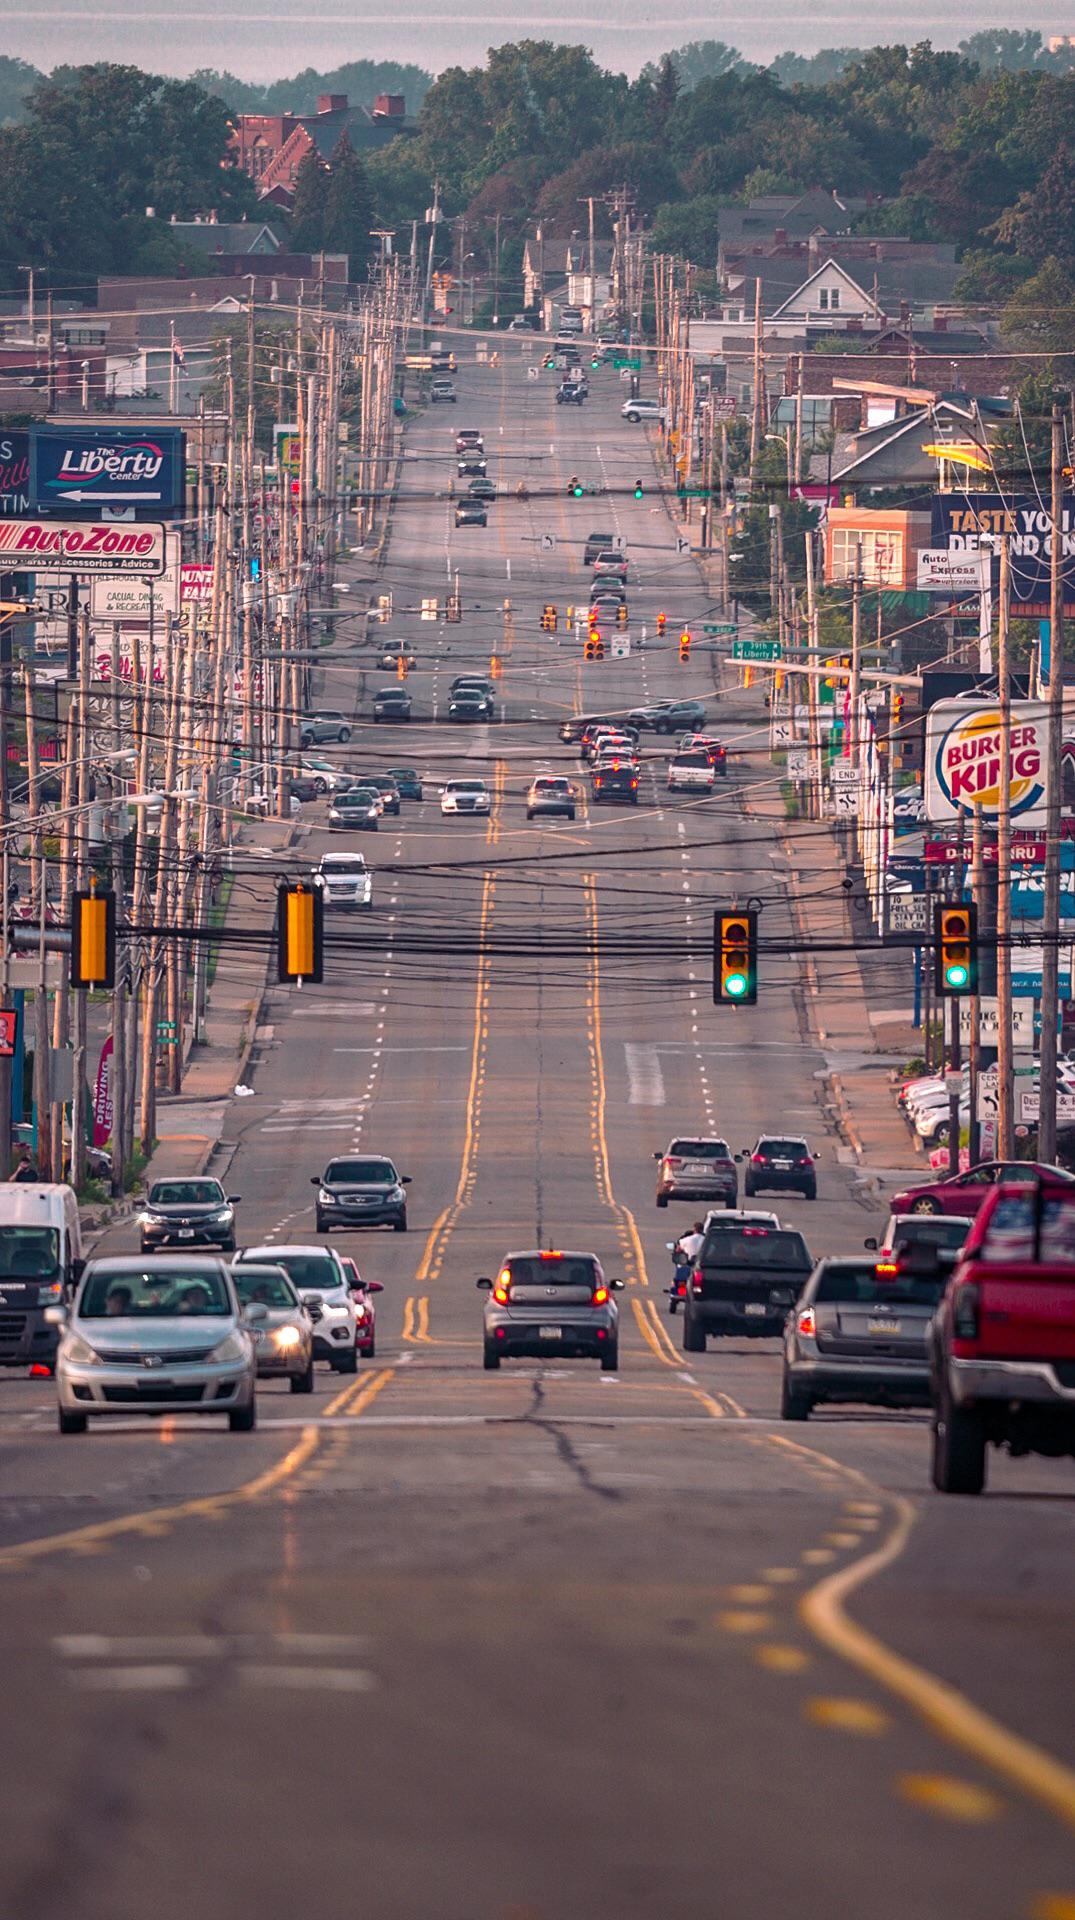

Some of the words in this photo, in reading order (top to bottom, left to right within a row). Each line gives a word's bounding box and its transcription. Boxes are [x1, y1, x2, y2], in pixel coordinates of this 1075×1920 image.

[97, 447, 115, 456] The
[60, 448, 163, 479] Liberty
[109, 472, 142, 481] Center
[949, 510, 1017, 532] TASTE
[15, 525, 154, 553] AutoZone
[949, 534, 1040, 556] DEEND
[121, 560, 153, 568] Advice
[922, 554, 947, 564] Auto
[930, 565, 976, 575] Express
[107, 592, 135, 601] CASUAL
[139, 592, 163, 601] DINNG
[116, 602, 164, 611] RECREATON
[744, 651, 769, 659] Liberty
[96, 1061, 108, 1124] DRIVING
